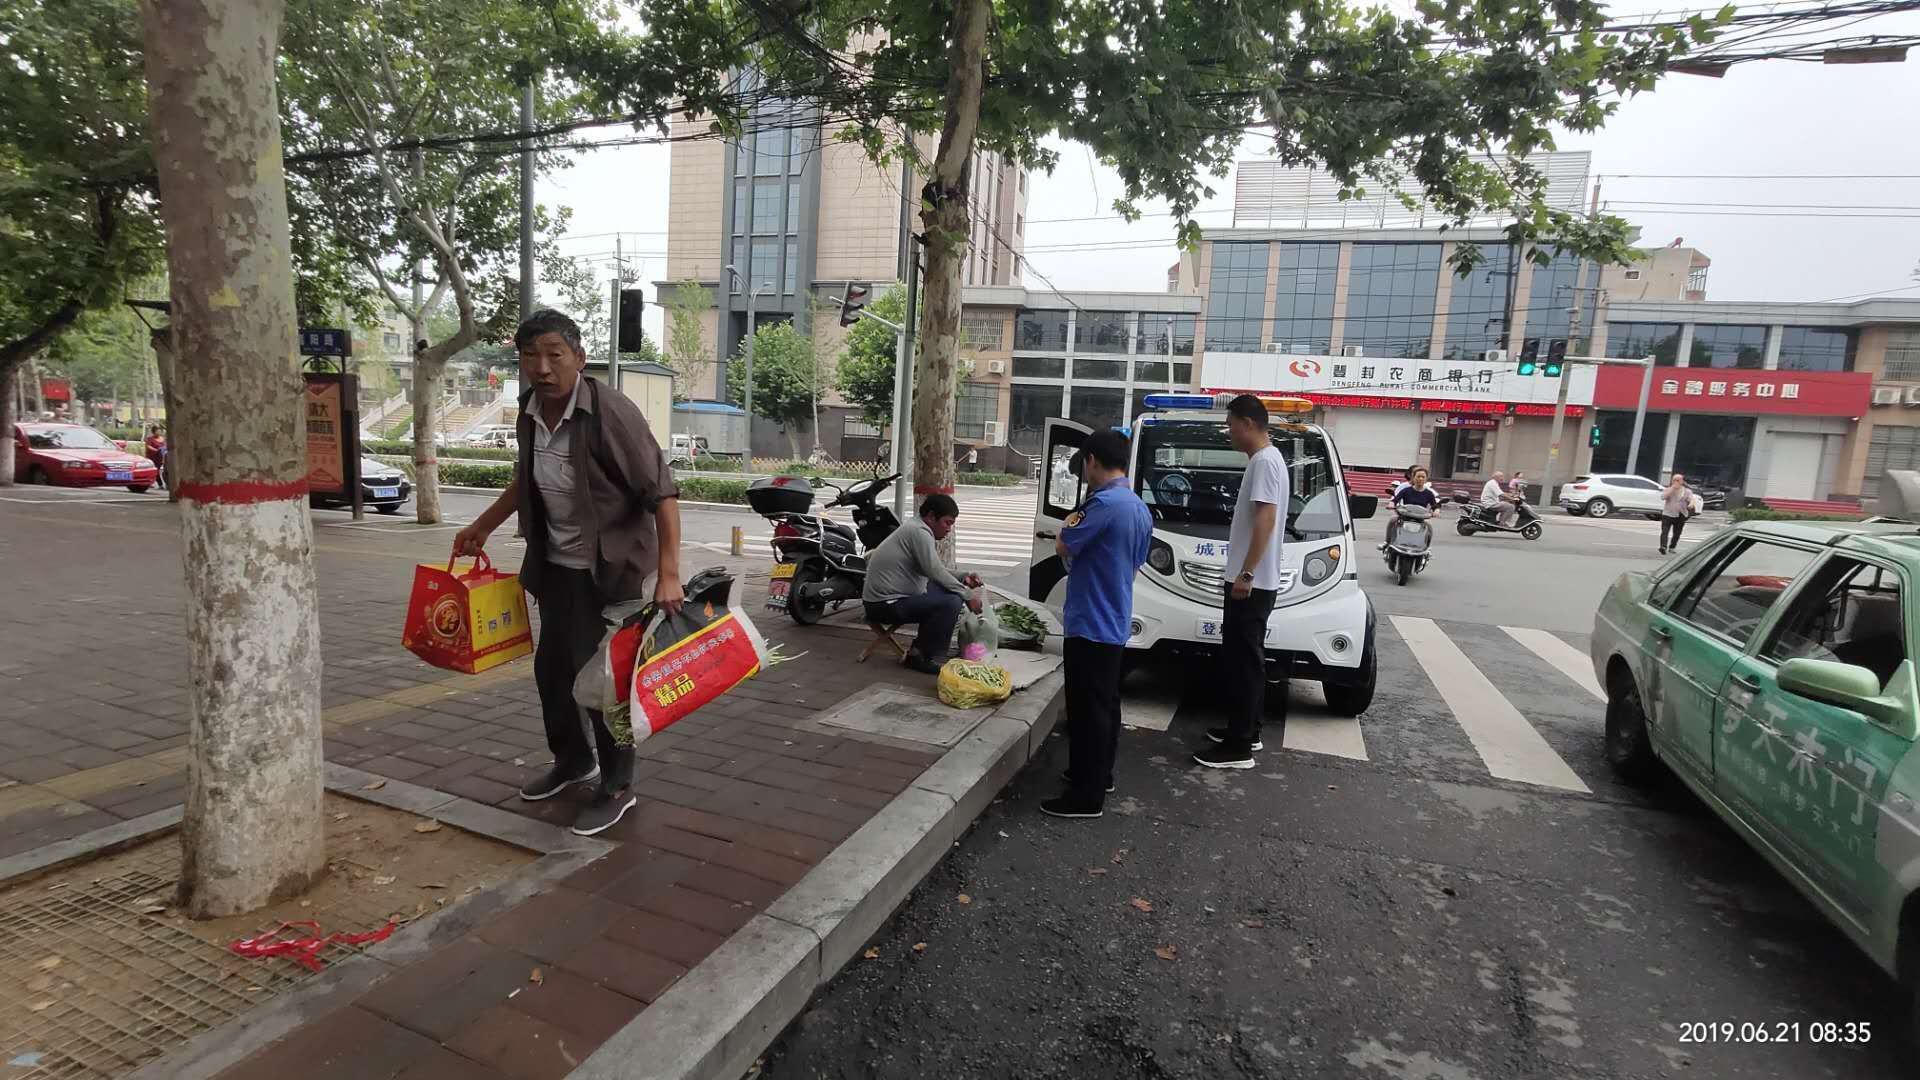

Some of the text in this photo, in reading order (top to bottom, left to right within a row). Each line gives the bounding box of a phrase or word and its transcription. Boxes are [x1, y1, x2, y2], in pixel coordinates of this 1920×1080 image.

[301, 333, 334, 346] 阳路
[1333, 364, 1493, 384] 登封农商银行
[1660, 379, 1800, 399] 金融服务中心
[1202, 622, 1224, 636] 登
[654, 672, 696, 707] 精品
